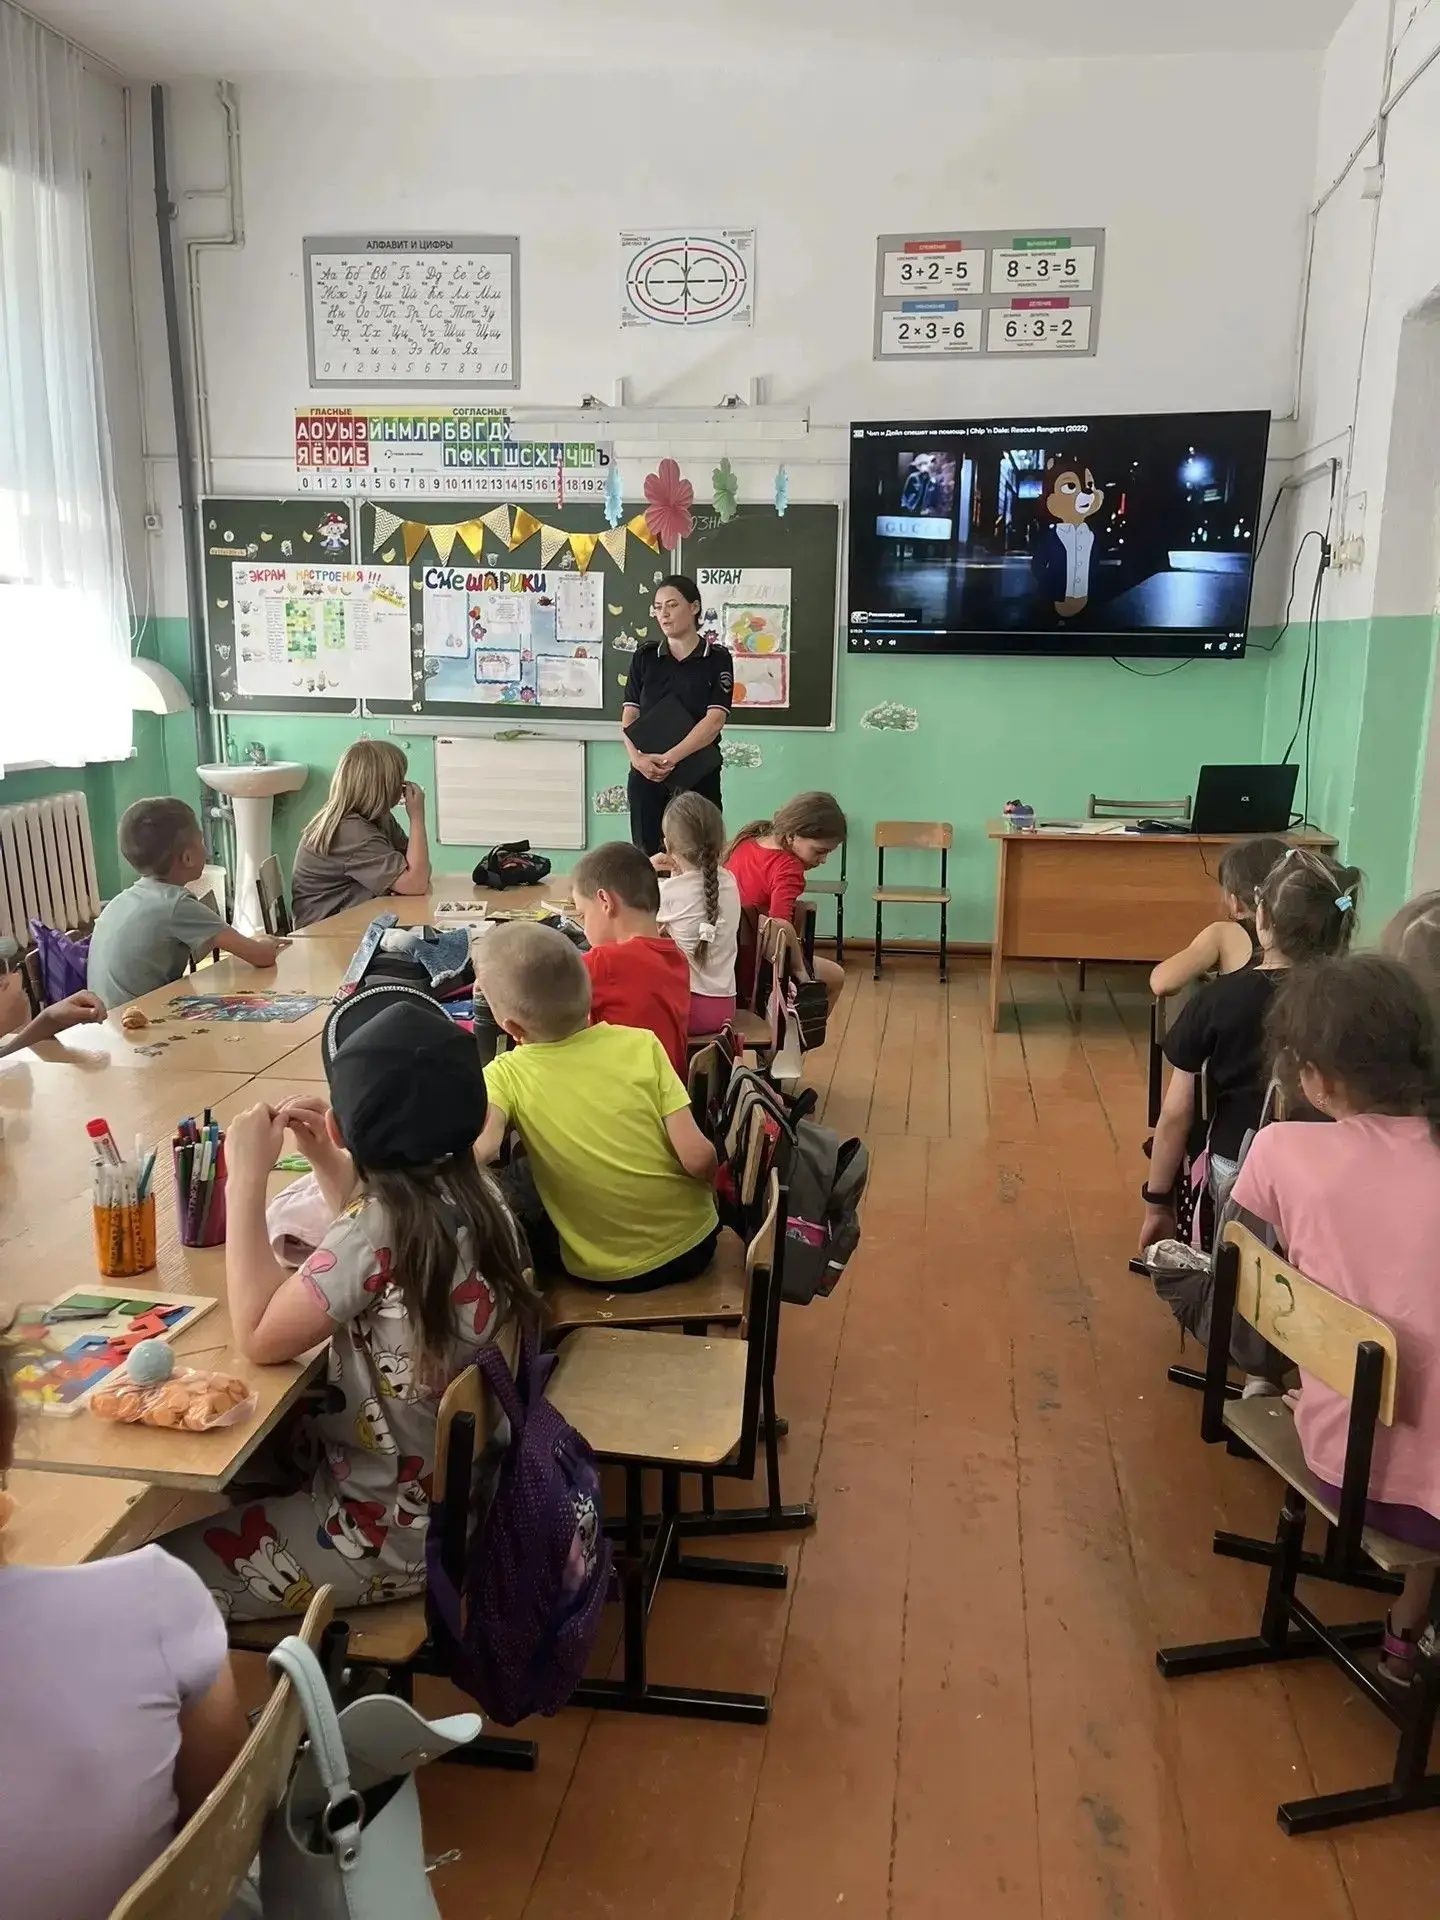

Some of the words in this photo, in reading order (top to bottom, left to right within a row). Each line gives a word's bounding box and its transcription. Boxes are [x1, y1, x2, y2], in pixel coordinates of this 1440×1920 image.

[366, 240, 408, 250] АЛФАВИТ
[410, 240, 418, 249] И
[420, 240, 454, 250] ЦИФРЫ
[324, 362, 330, 373] 0
[342, 362, 347, 373] 1
[357, 362, 364, 373] 2
[374, 362, 381, 373] 3
[391, 362, 397, 373] 4
[406, 362, 414, 373] 5
[424, 362, 431, 373] 6
[440, 362, 448, 373] 7
[458, 362, 465, 373] 8
[476, 362, 482, 373] 9
[494, 362, 508, 373] 10
[310, 408, 352, 416] ГЛАСНЫЕ
[452, 408, 508, 416] СОГЛАСНЫЕ
[970, 428, 985, 436] Chip
[1036, 426, 1064, 434] Rangers
[1066, 424, 1088, 434] (2022)
[302, 478, 309, 489] 0
[318, 478, 322, 489] 1
[331, 478, 338, 489] 2
[345, 478, 352, 489] 3
[360, 478, 366, 489] 4
[374, 478, 381, 489] 5
[389, 478, 396, 489] 6
[404, 478, 410, 489] 7
[418, 478, 425, 489] 8
[433, 478, 440, 489] 9
[446, 478, 458, 489] 10
[462, 478, 472, 490] 11
[476, 478, 488, 490] 12
[490, 479, 502, 490] 13
[506, 479, 518, 490] 14
[520, 479, 532, 490] 15
[536, 480, 548, 490] 16
[566, 480, 578, 490] 18
[582, 480, 594, 490] 19
[250, 568, 286, 583] ЭКРАН
[296, 569, 364, 582] НАСТРОЕНИЯ
[701, 569, 742, 585] ЭКРАН
